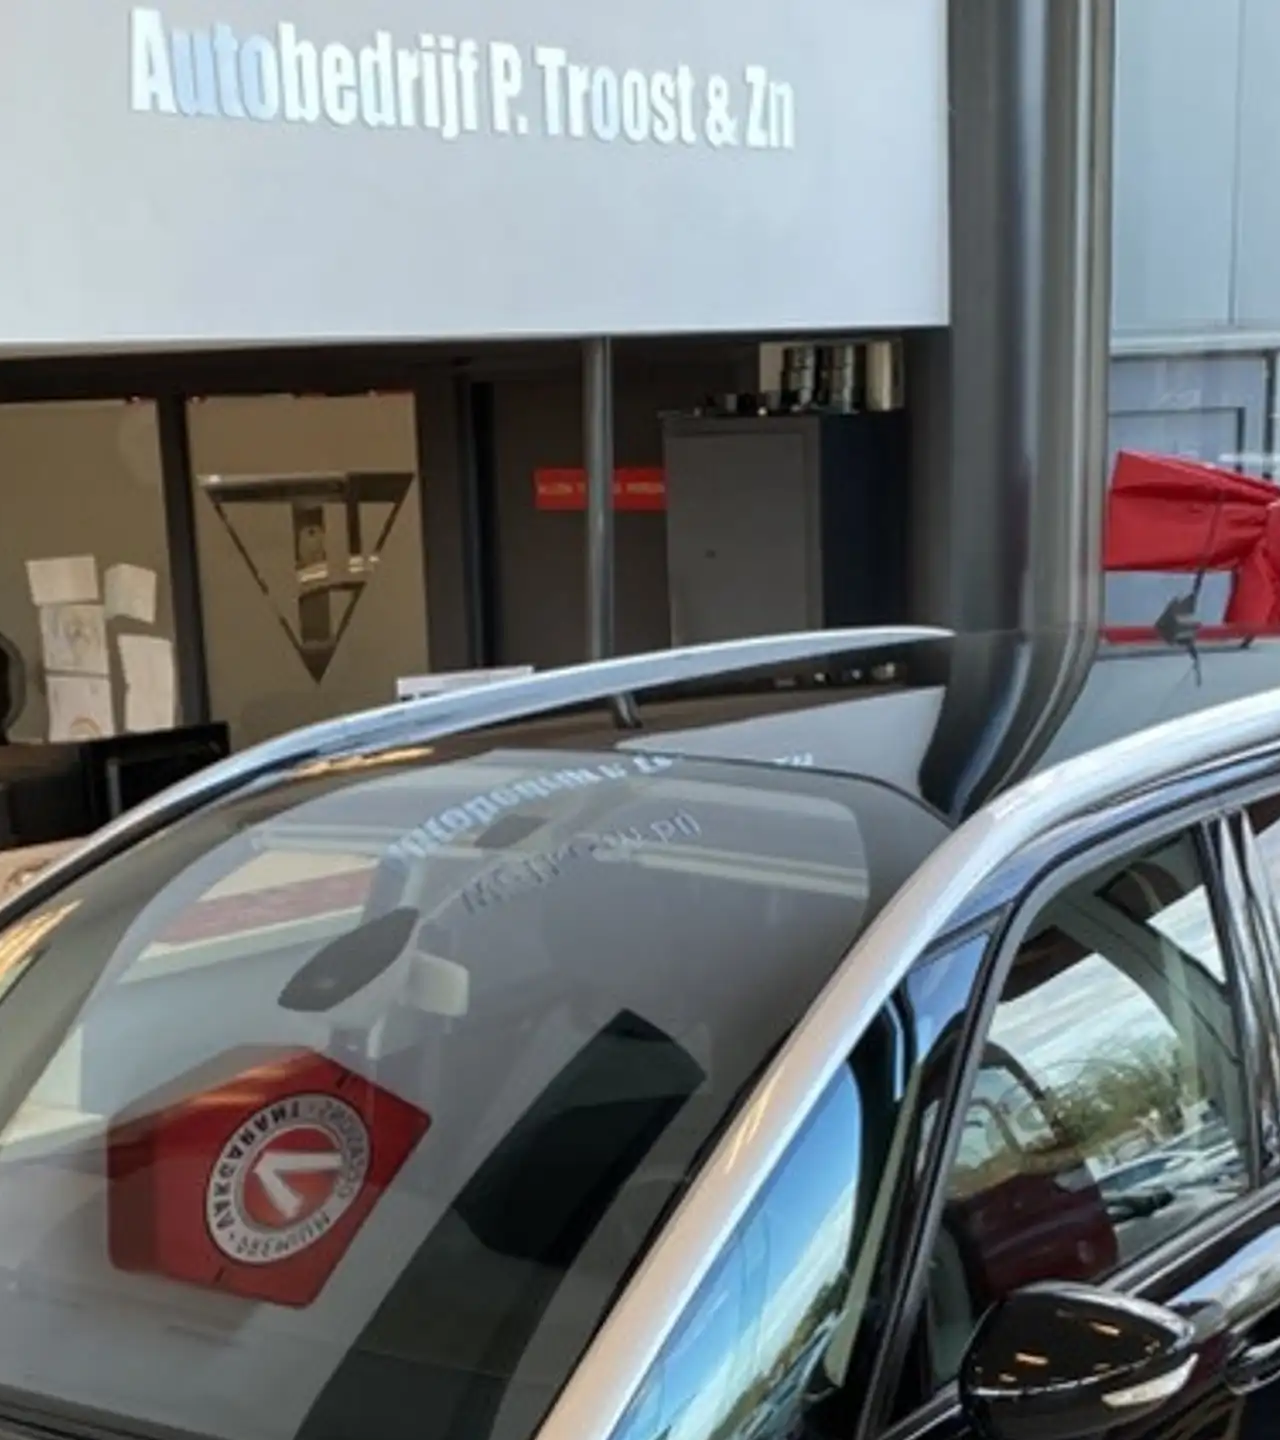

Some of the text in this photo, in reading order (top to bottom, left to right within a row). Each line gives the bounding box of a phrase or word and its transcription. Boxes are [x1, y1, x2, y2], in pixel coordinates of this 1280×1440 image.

[131, 7, 794, 149] Autobedrijf P. Troost & Zn
